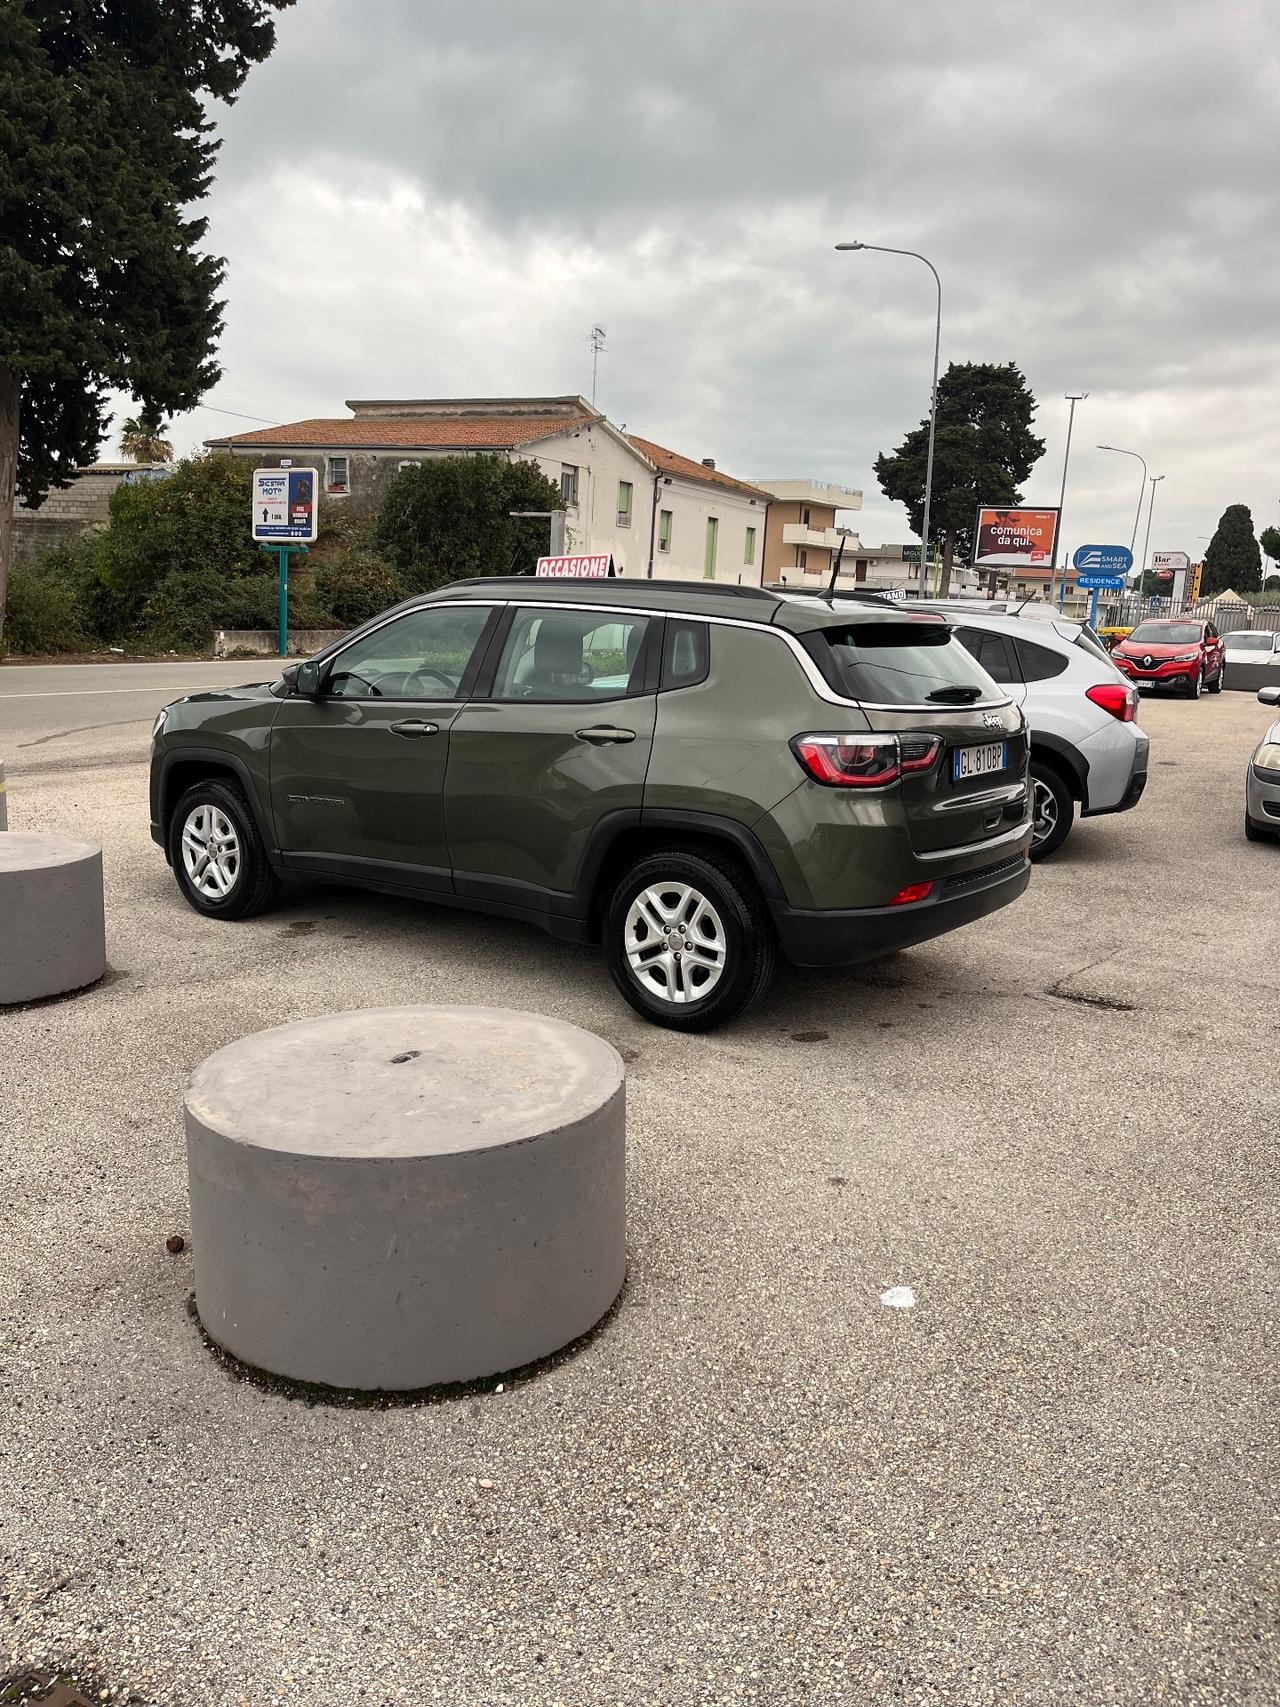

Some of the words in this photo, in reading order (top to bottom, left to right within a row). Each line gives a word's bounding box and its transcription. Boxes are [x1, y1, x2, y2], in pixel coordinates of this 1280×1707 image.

[990, 526, 1042, 536] comunica
[997, 535, 1011, 545] da
[1013, 536, 1032, 547] qui.
[540, 558, 607, 577] OCCASIONE
[1080, 577, 1120, 585] RESIDENCE
[982, 713, 1003, 729] Jeep
